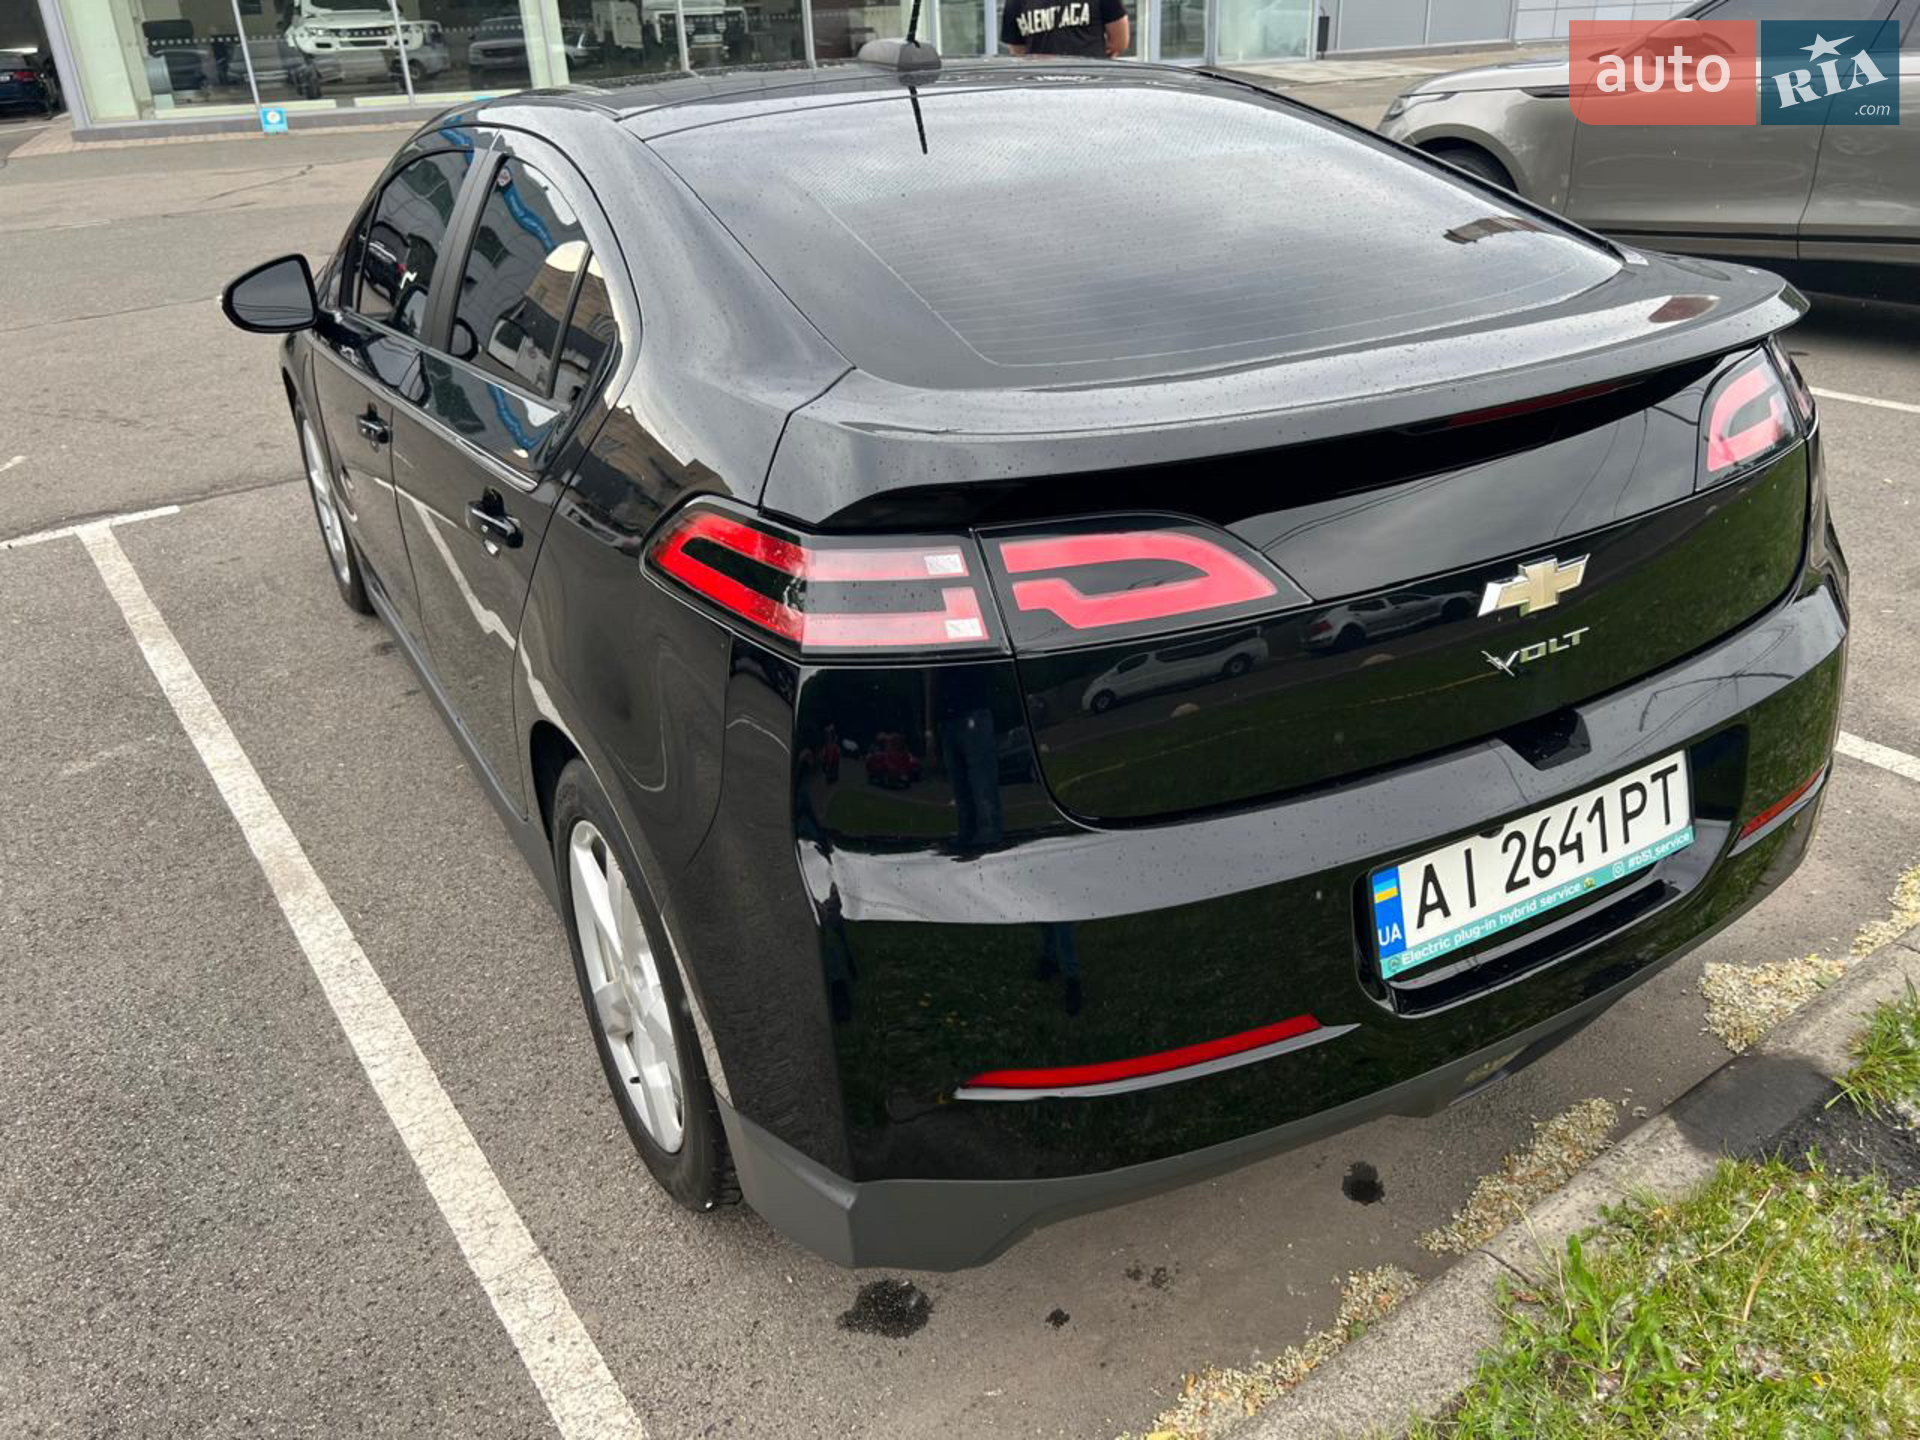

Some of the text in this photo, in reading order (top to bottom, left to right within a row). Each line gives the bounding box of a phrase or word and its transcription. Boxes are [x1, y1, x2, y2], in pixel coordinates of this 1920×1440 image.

[1481, 627, 1590, 677] VOLT
[1416, 763, 1678, 929] AI 2641 PT
[1378, 922, 1402, 946] UA
[1401, 883, 1580, 965] Electric plug-in hybrid service
